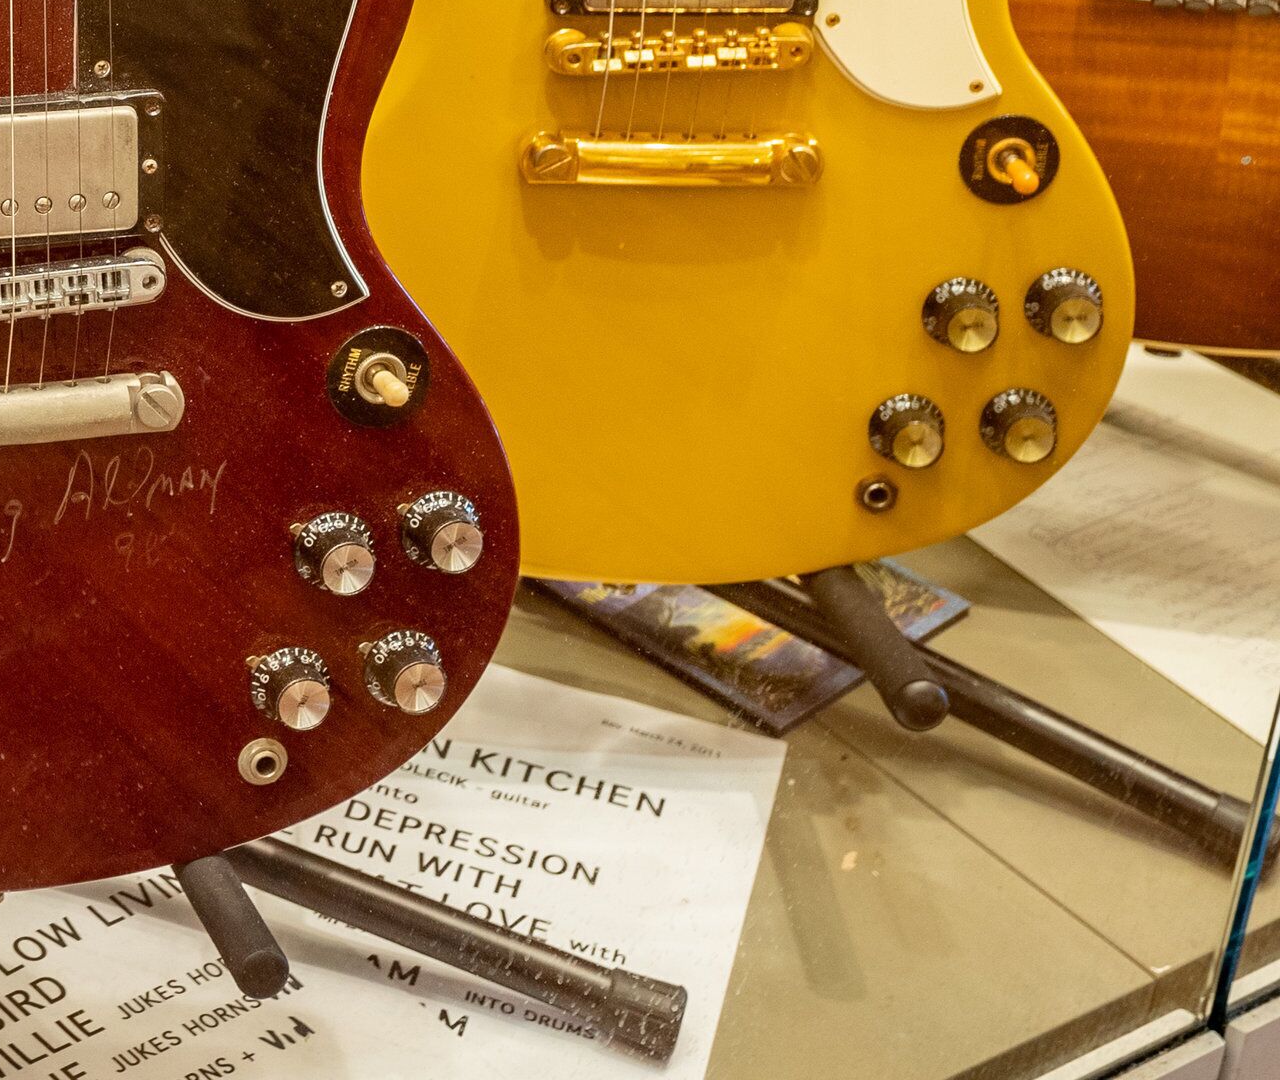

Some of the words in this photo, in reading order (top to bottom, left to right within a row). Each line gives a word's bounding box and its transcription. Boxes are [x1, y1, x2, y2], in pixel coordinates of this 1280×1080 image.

[337, 347, 362, 393] RHYTHM
[469, 746, 667, 819] KITCHEN
[489, 785, 552, 811] guitar
[313, 823, 398, 864] RUN
[416, 850, 523, 899] WITH
[343, 798, 601, 887] DEPRESSION
[569, 936, 627, 965] with
[120, 979, 187, 1021] JUKES
[464, 989, 517, 1015] INTO
[523, 1008, 598, 1040] DRUMS
[110, 1030, 183, 1074] JUKES
[182, 994, 262, 1037] HORNS
